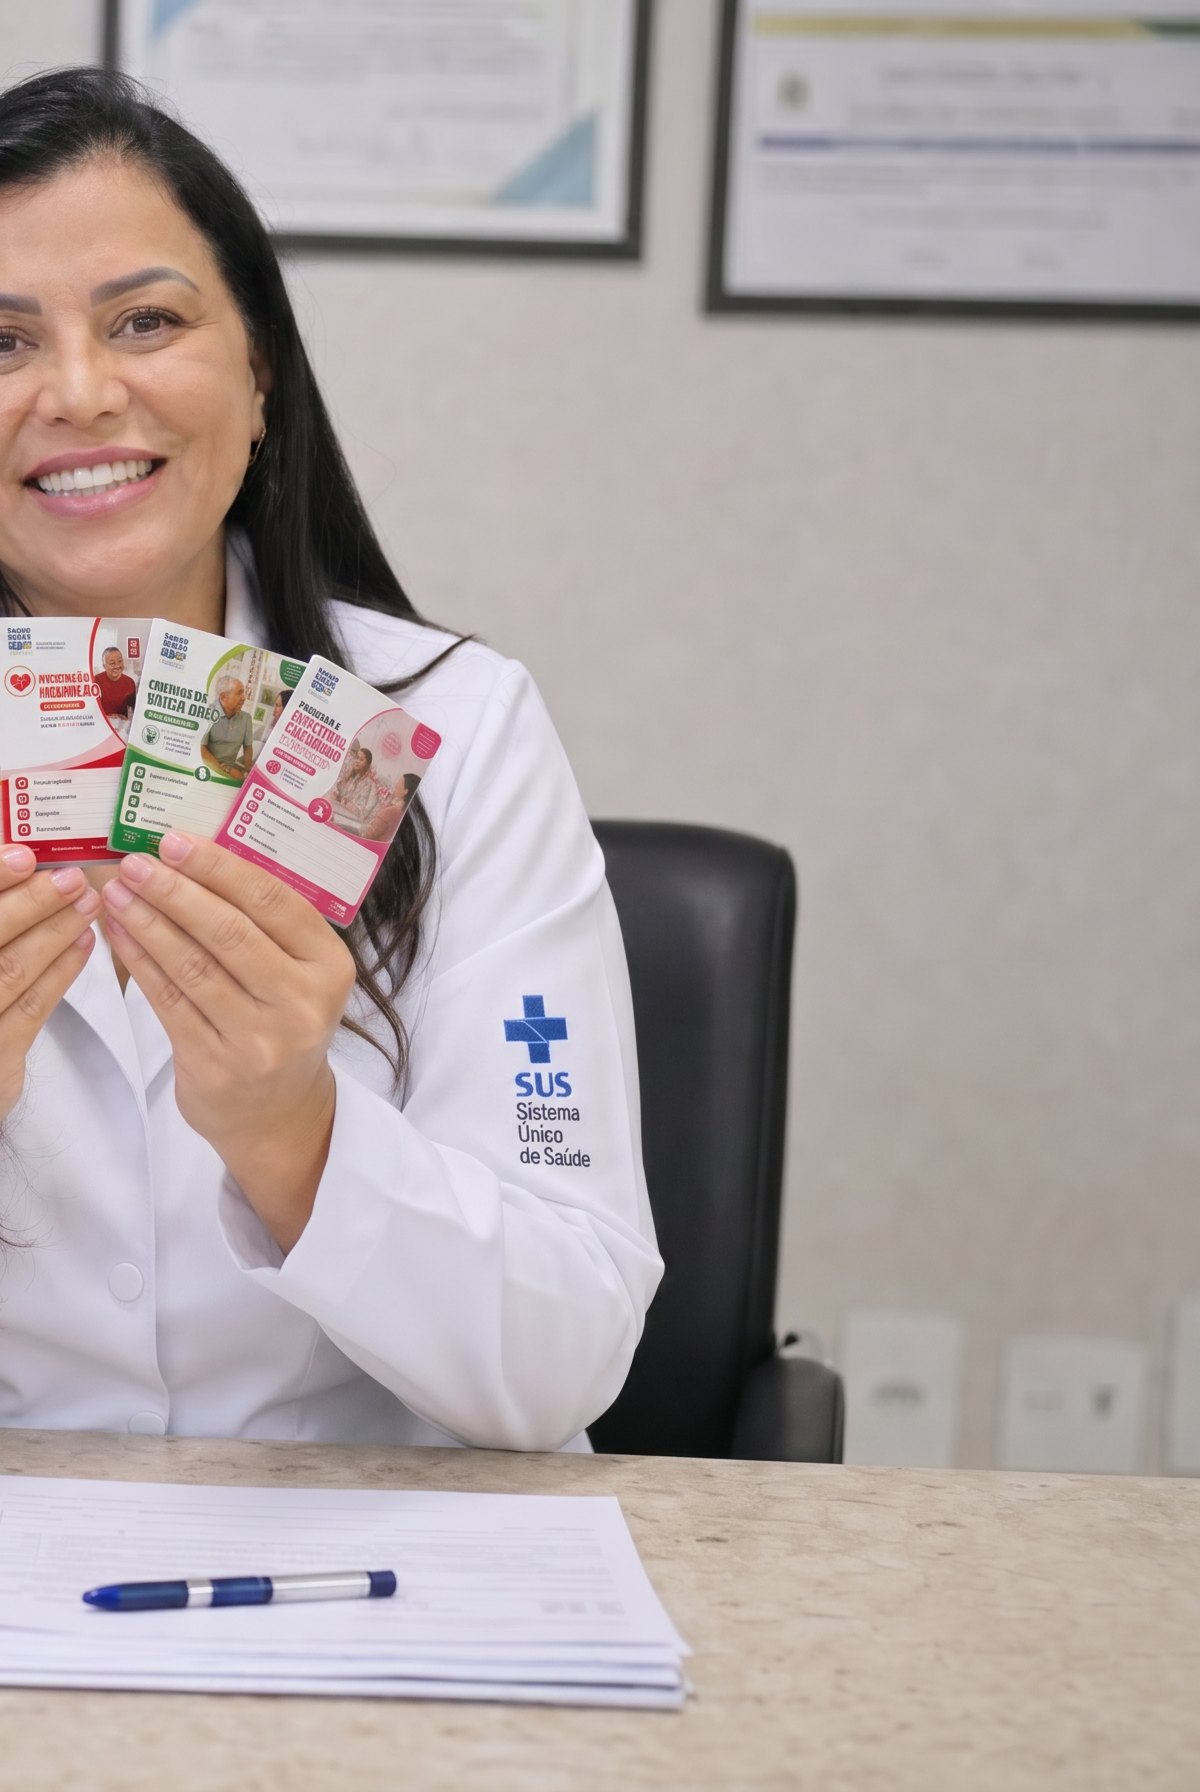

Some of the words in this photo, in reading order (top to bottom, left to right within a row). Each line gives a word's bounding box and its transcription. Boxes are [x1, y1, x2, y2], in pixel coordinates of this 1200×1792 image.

[515, 1072, 572, 1098] SUS
[520, 1147, 540, 1164] de
[544, 1147, 591, 1168] Saúde
